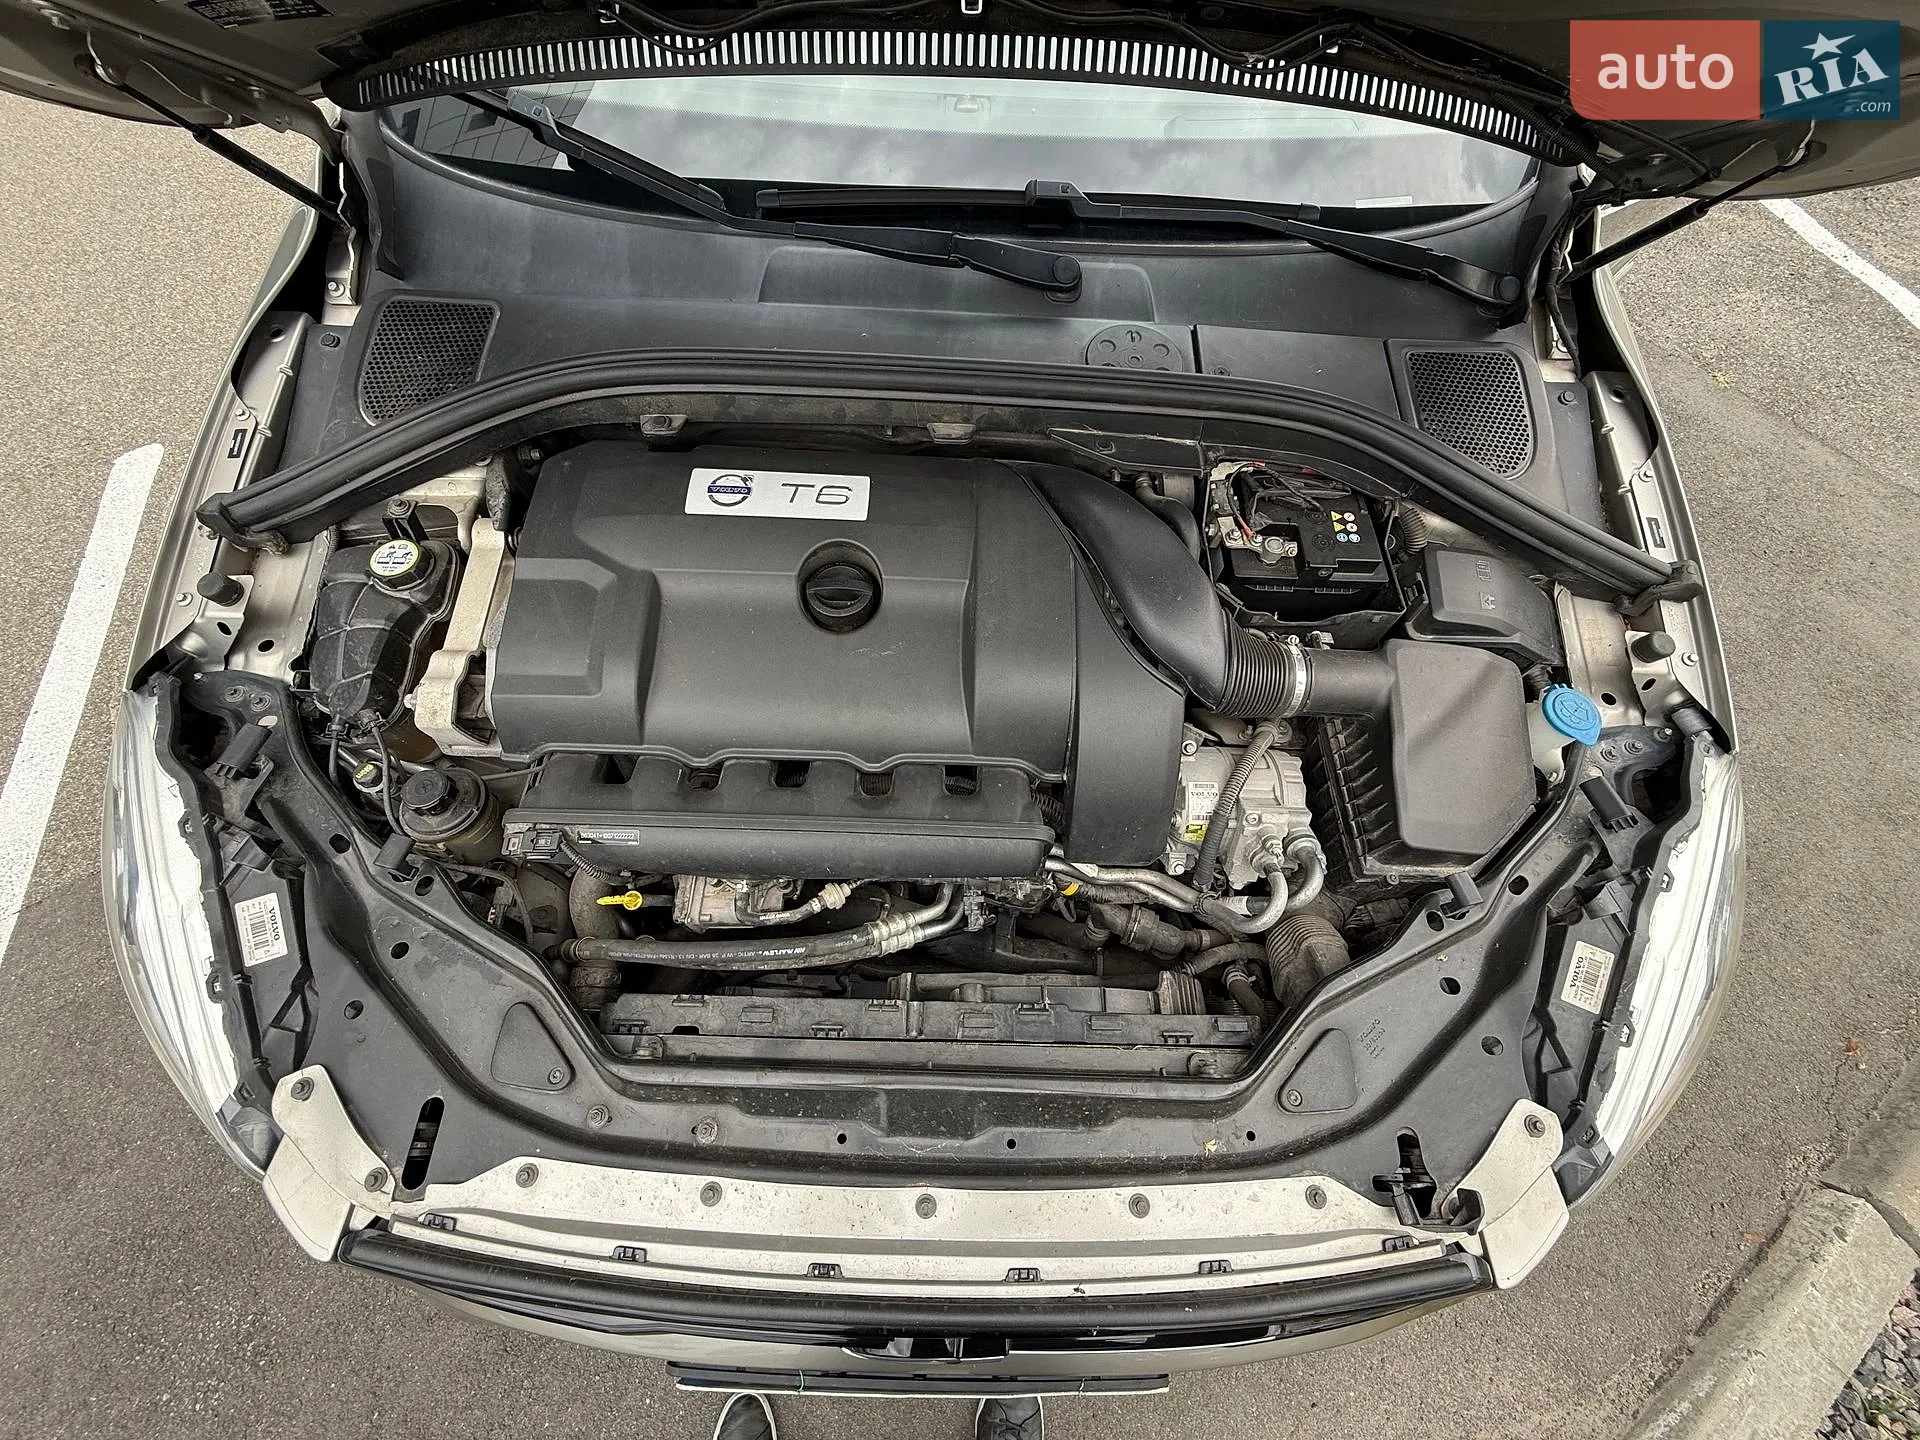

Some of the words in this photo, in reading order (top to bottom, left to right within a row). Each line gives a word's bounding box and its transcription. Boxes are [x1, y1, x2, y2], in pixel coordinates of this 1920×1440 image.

[709, 486, 748, 494] VOLVO
[781, 483, 853, 506] T6
[269, 907, 281, 941] VOLVO
[1570, 956, 1584, 987] VOLVO
